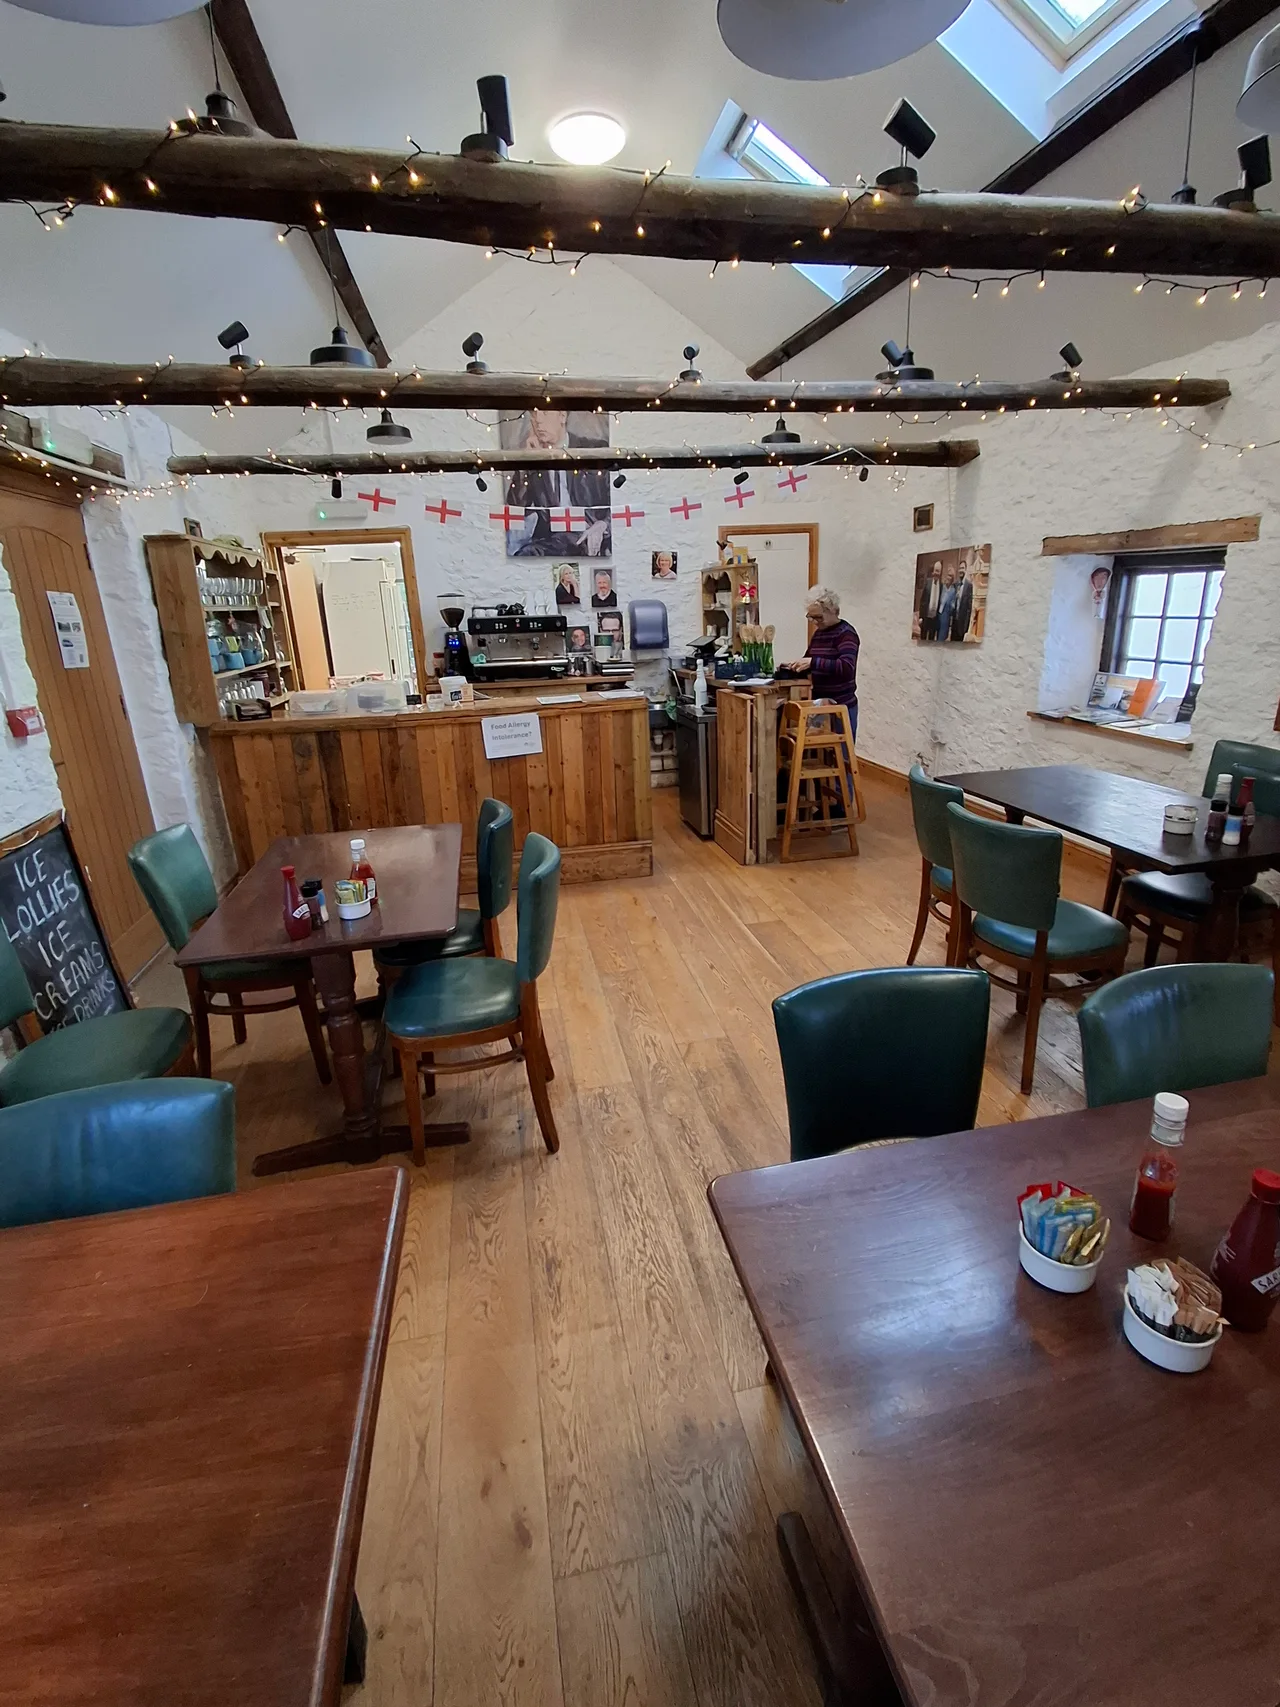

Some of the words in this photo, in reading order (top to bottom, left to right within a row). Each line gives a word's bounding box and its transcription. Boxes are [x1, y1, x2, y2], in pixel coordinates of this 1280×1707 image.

[491, 731, 532, 741] Intolerance?
[508, 721, 531, 729] Allergy
[14, 849, 47, 892] ICE
[1, 869, 80, 943] LOLLIES
[38, 920, 76, 968] ICE
[34, 942, 104, 1020] CREAMS
[72, 969, 116, 1022] DRINKS
[1258, 1271, 1280, 1289] SAR
